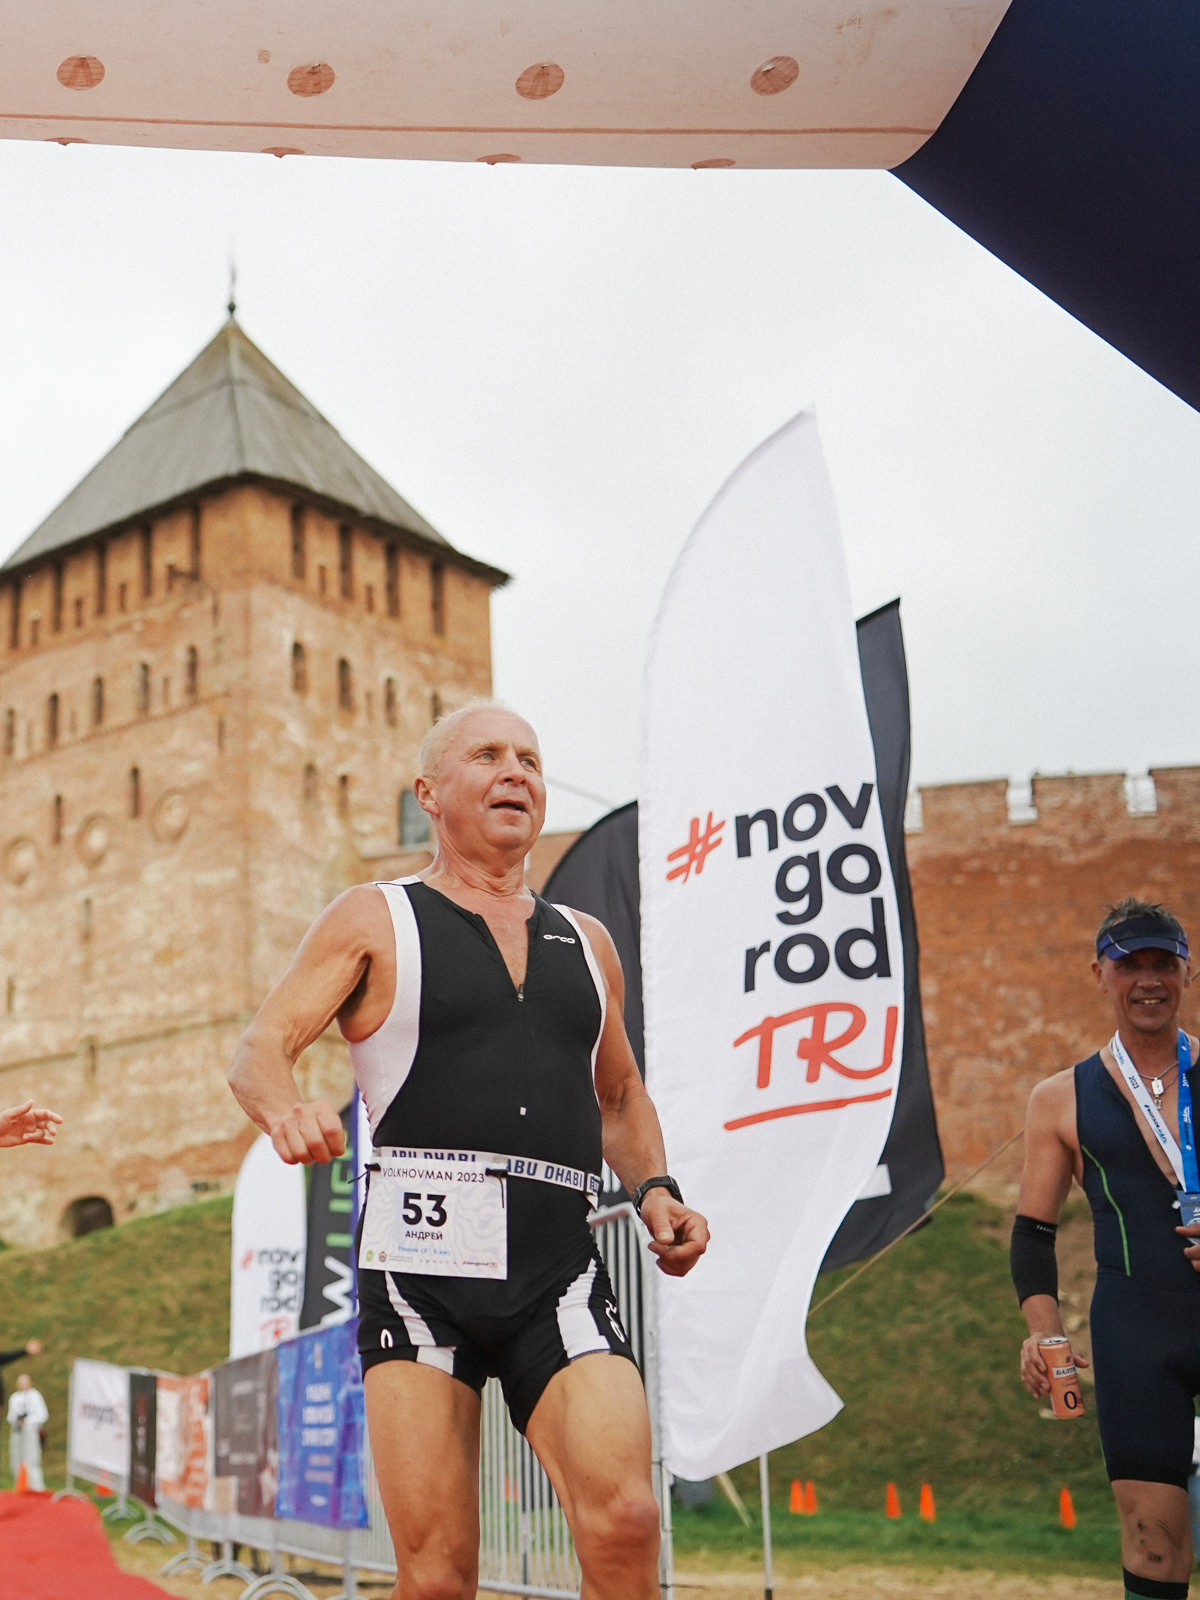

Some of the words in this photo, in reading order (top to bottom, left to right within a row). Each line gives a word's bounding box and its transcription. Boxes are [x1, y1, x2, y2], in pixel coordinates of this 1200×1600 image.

[665, 782, 875, 885] #nov
[774, 843, 883, 926] go
[543, 934, 576, 945] orca
[743, 897, 892, 994] rod
[733, 1002, 899, 1089] TRI
[382, 1167, 453, 1182] VOLKHOVMAN
[456, 1171, 485, 1183] 2023
[544, 1165, 583, 1188] DHABI
[401, 1191, 448, 1228] 53
[405, 1230, 443, 1241] АНДРЕЙ
[1063, 1390, 1078, 1410] 0
